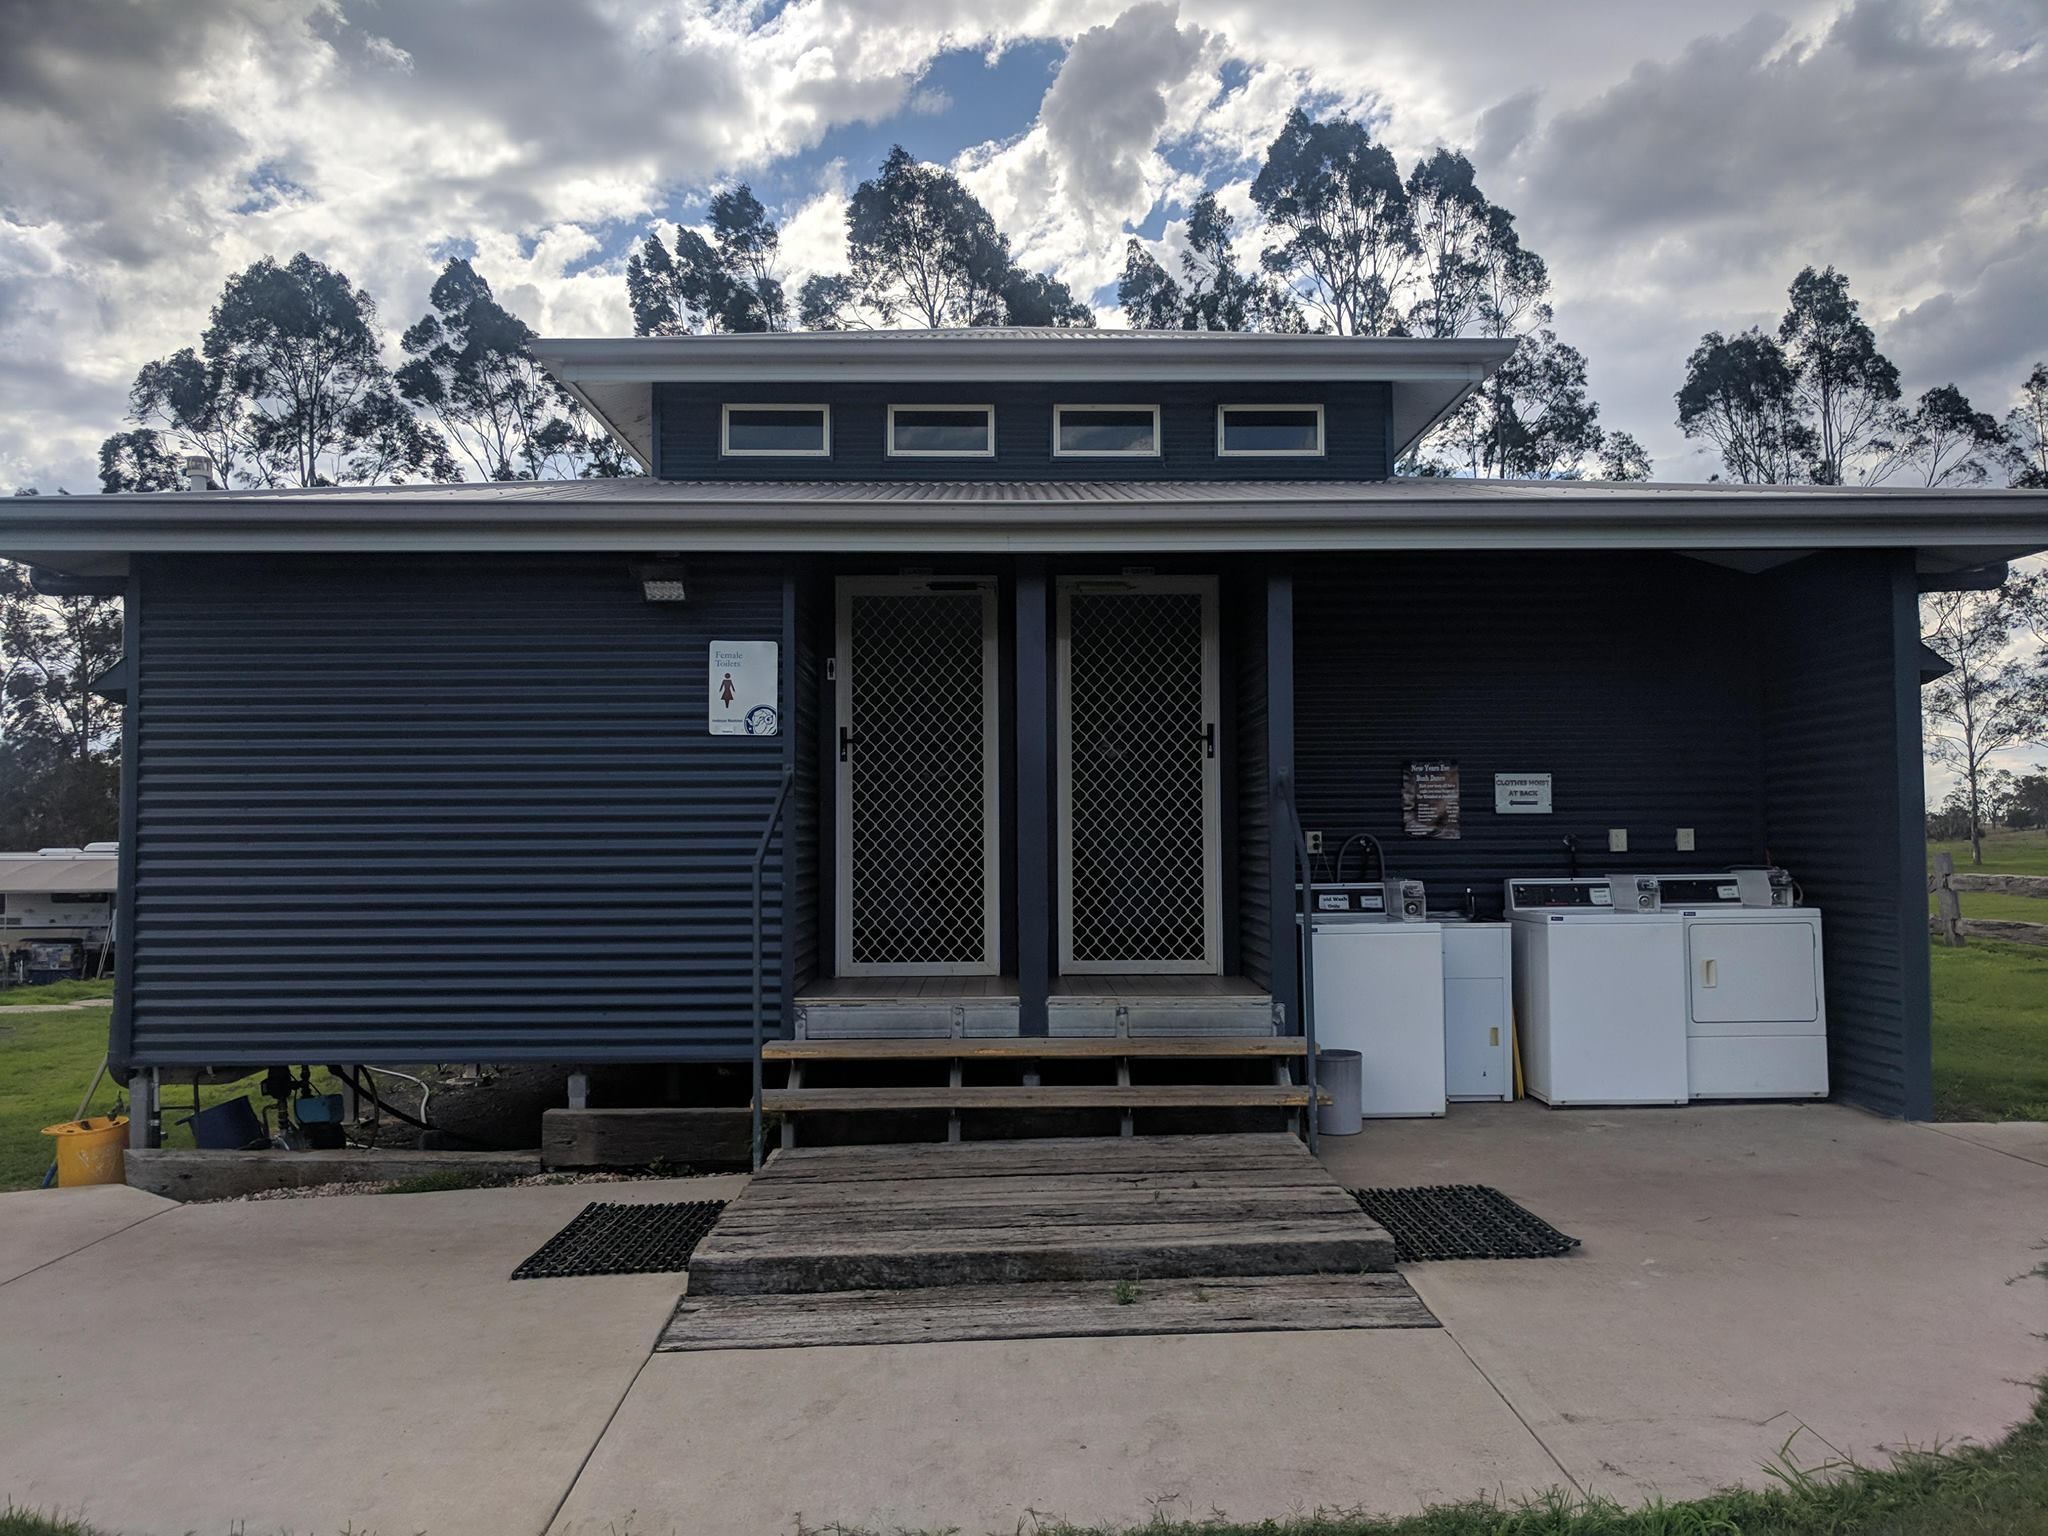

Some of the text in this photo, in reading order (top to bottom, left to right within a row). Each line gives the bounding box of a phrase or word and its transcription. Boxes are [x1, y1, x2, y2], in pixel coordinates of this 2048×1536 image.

[715, 651, 743, 659] Female
[1411, 764, 1450, 772] New Years Eve
